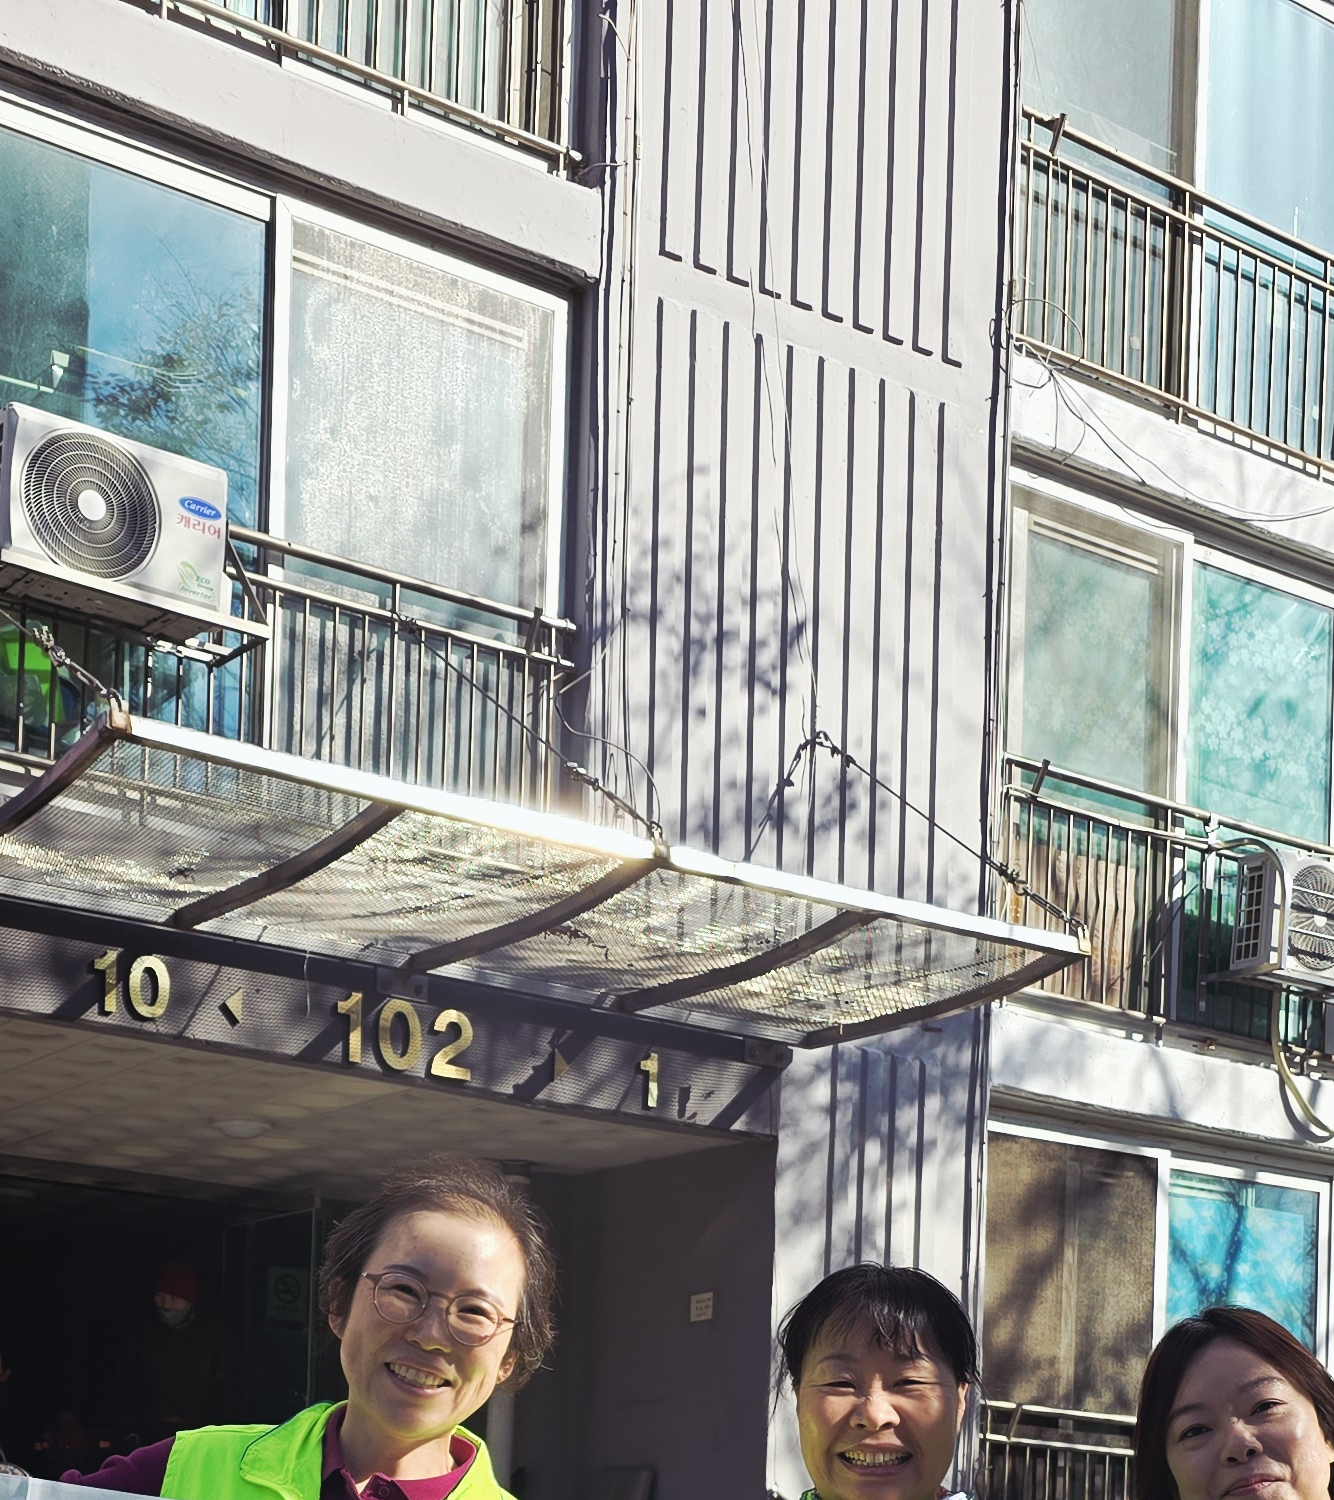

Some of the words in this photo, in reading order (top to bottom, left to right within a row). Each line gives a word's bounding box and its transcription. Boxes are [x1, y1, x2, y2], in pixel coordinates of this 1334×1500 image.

[183, 498, 217, 518] Carrier
[175, 512, 222, 540] 캐리어
[93, 948, 171, 1020] 10
[336, 990, 474, 1080] 102
[639, 1052, 659, 1108] 1
